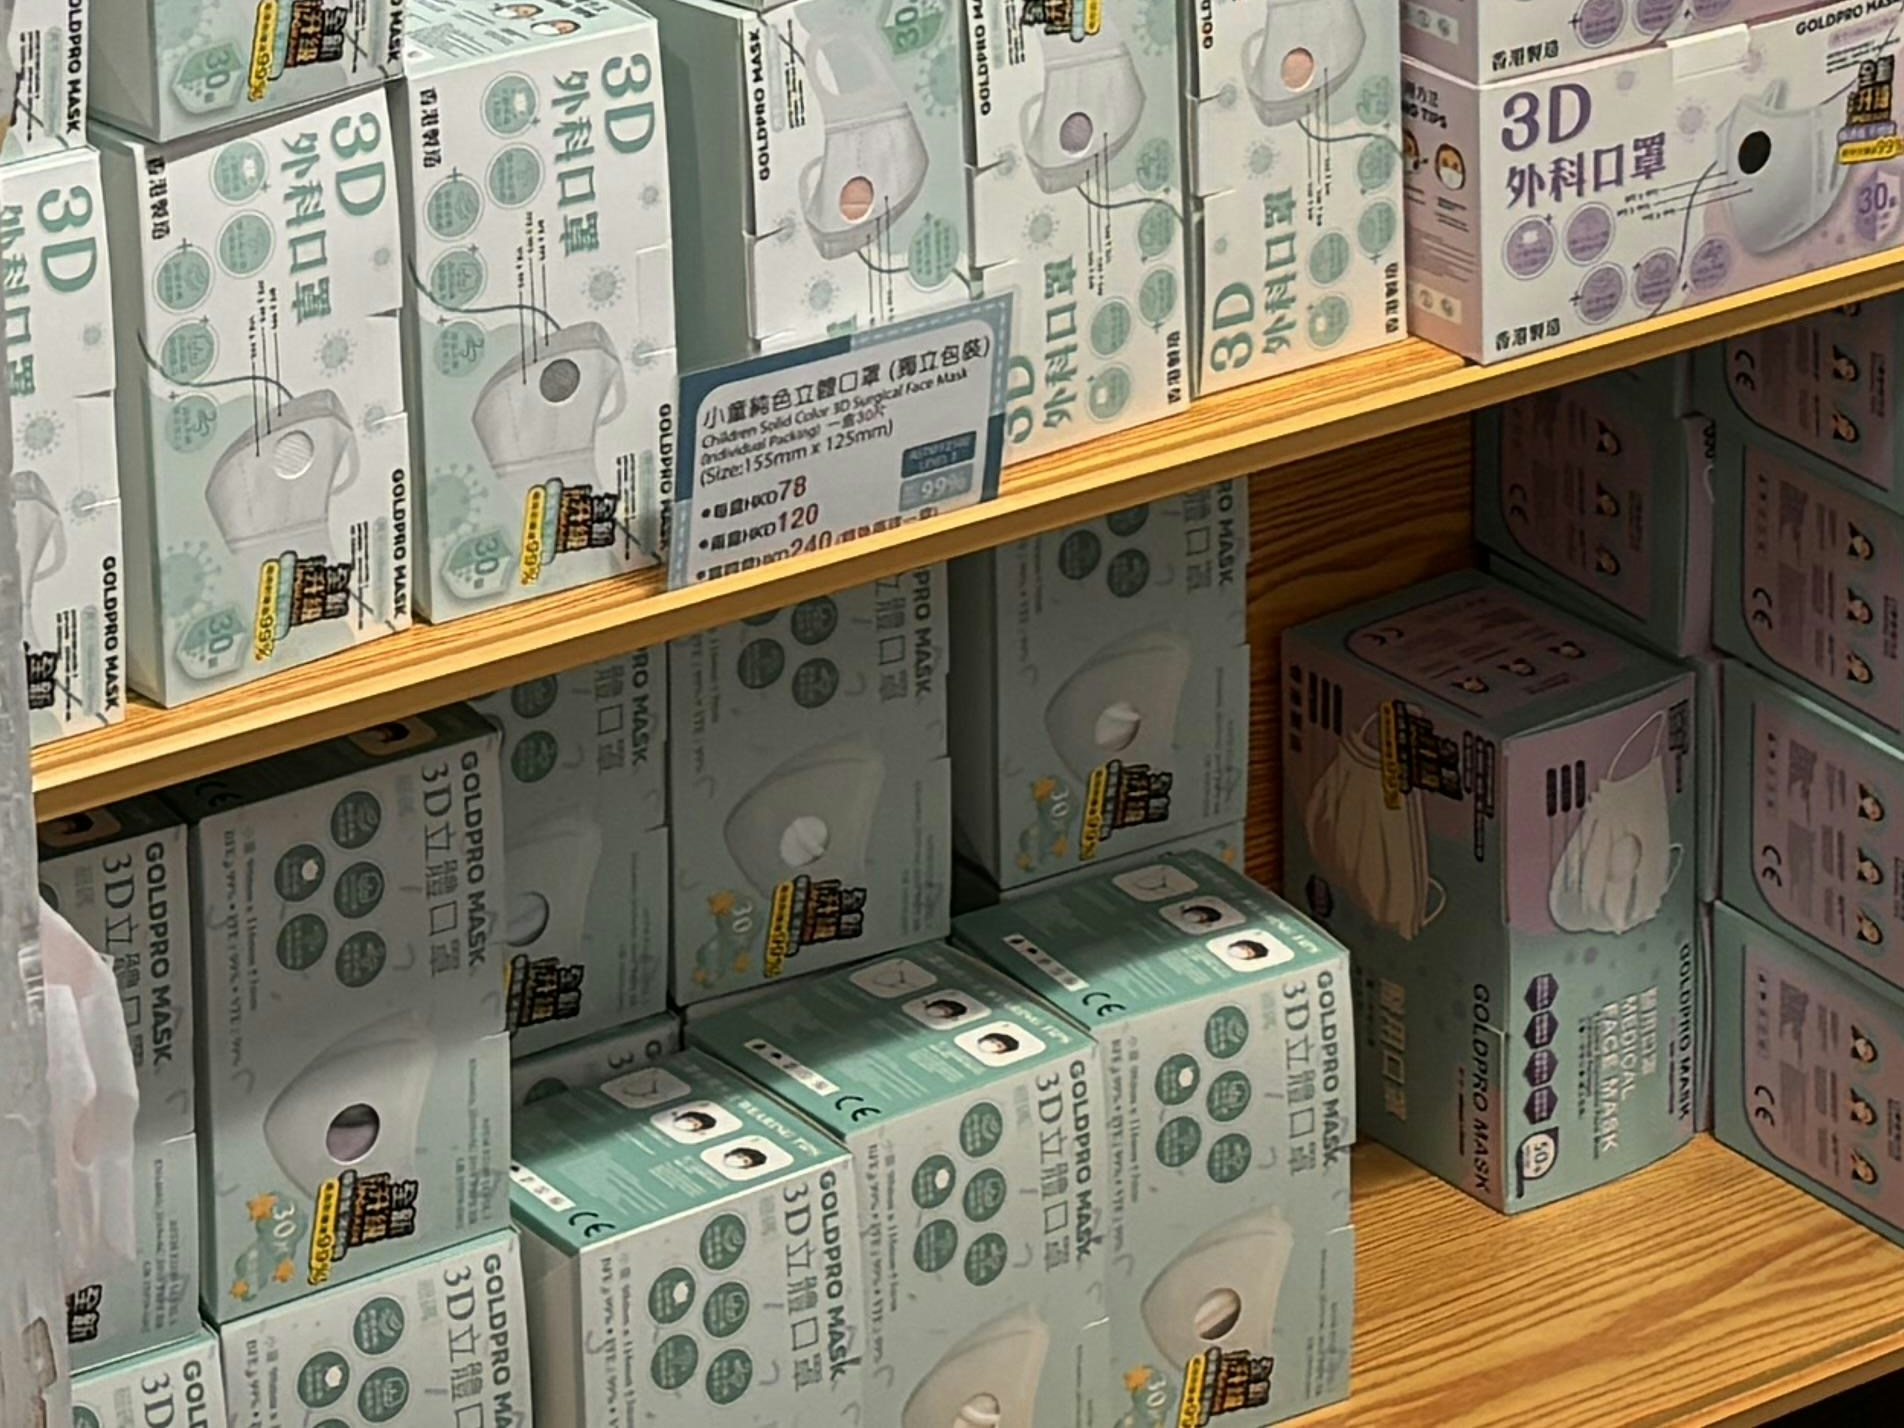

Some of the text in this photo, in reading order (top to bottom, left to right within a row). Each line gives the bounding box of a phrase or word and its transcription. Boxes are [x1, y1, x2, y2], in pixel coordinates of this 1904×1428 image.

[1501, 82, 1593, 154] 3D
[1506, 131, 1667, 208] 外科口罩
[1261, 183, 1298, 358] 外科口罩
[702, 336, 991, 429] 小童純色立體口罩 (獨立包裝)
[698, 418, 894, 488] (Size:155mm 125mm)
[101, 555, 121, 713] GOLDPRO MASK
[145, 840, 175, 1069] GOLDPRO MASK
[1313, 969, 1338, 1172] GOLDPRO MASK
